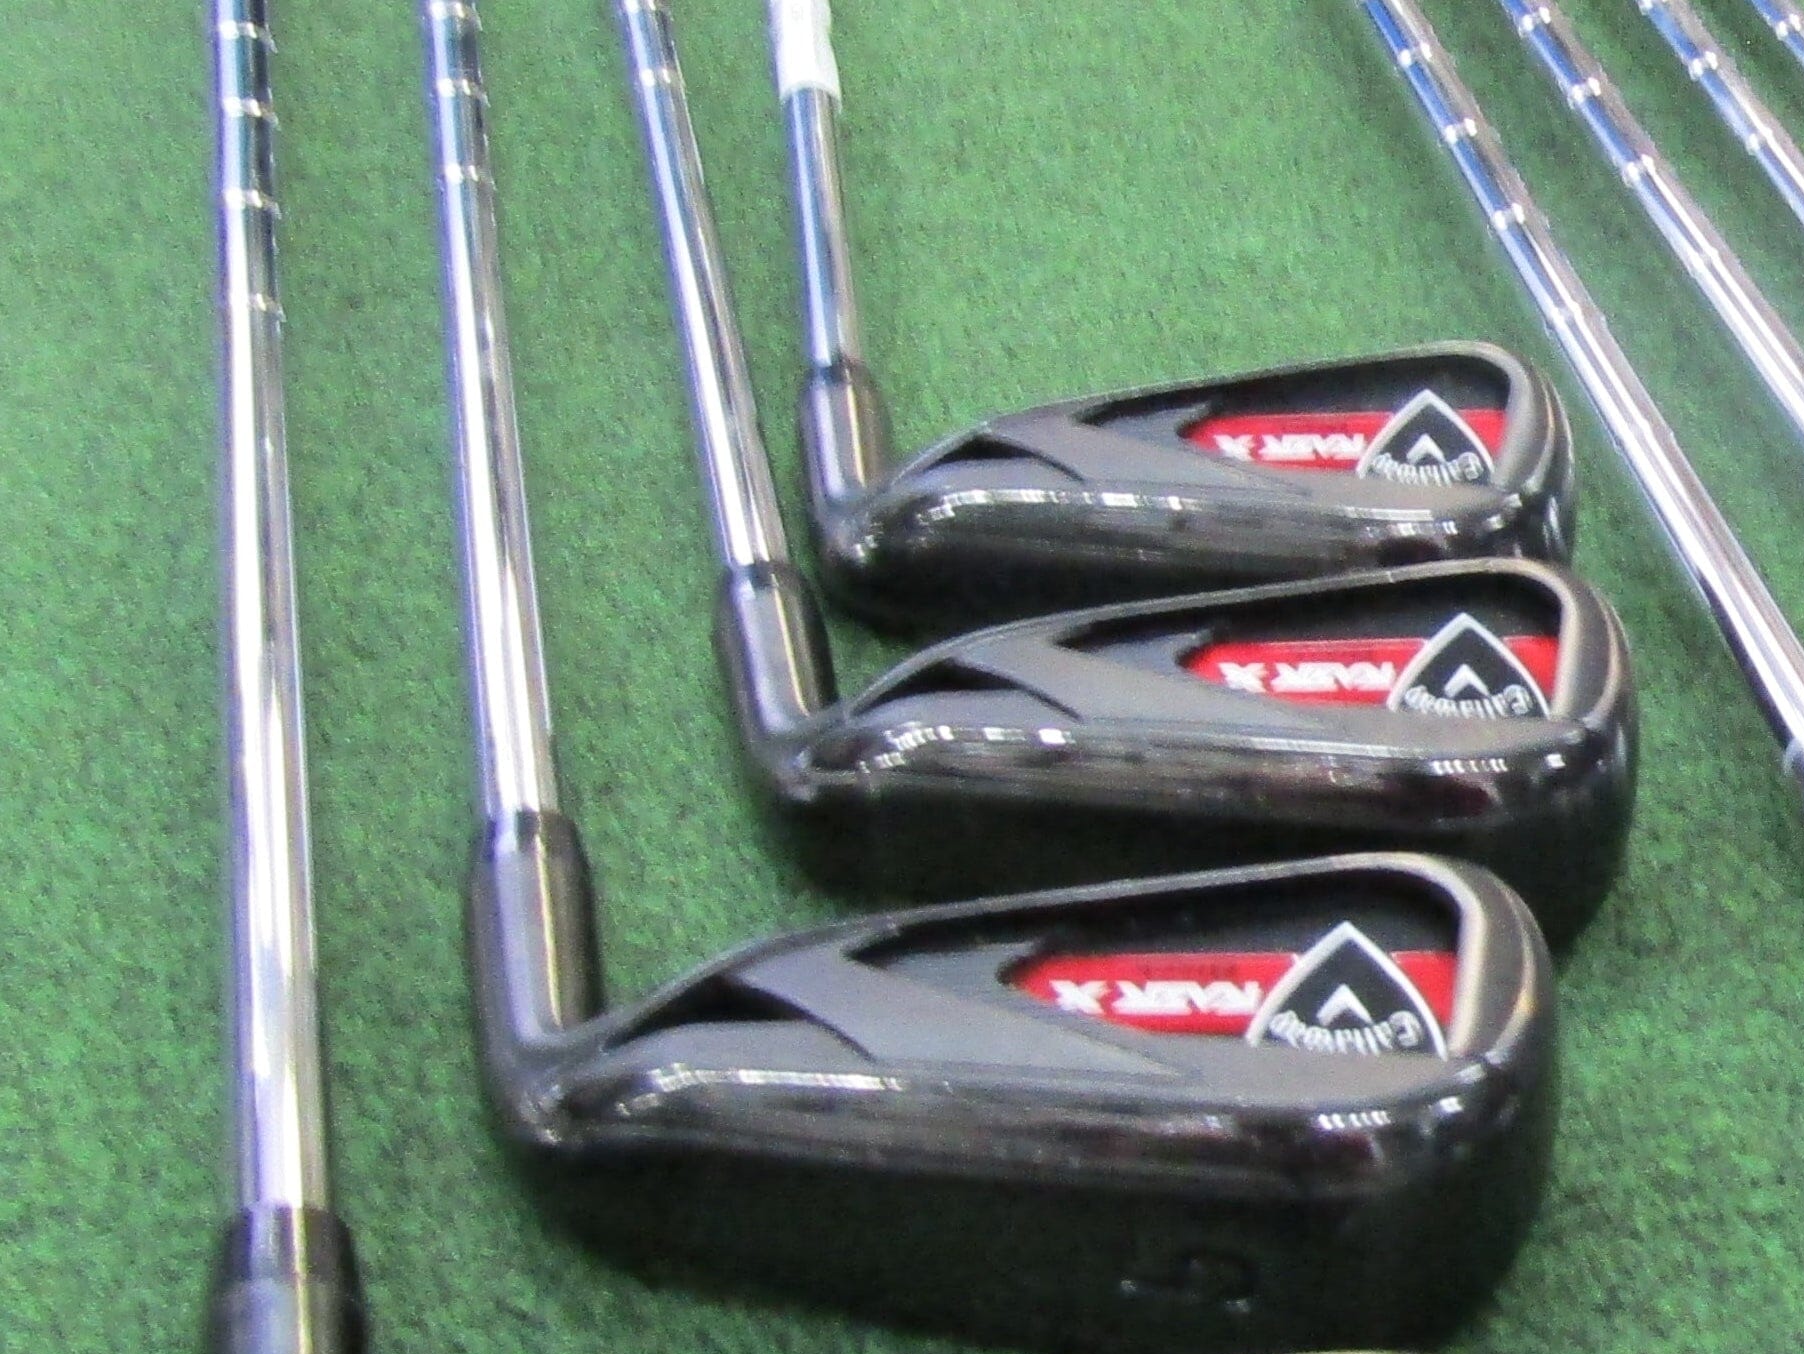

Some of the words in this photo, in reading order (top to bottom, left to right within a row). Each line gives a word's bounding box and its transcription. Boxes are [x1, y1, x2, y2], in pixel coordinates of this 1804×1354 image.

[1214, 434, 1255, 461] X
[1218, 662, 1267, 693] X
[1050, 980, 1110, 1015] X
[1268, 1010, 1422, 1055] Callaway
